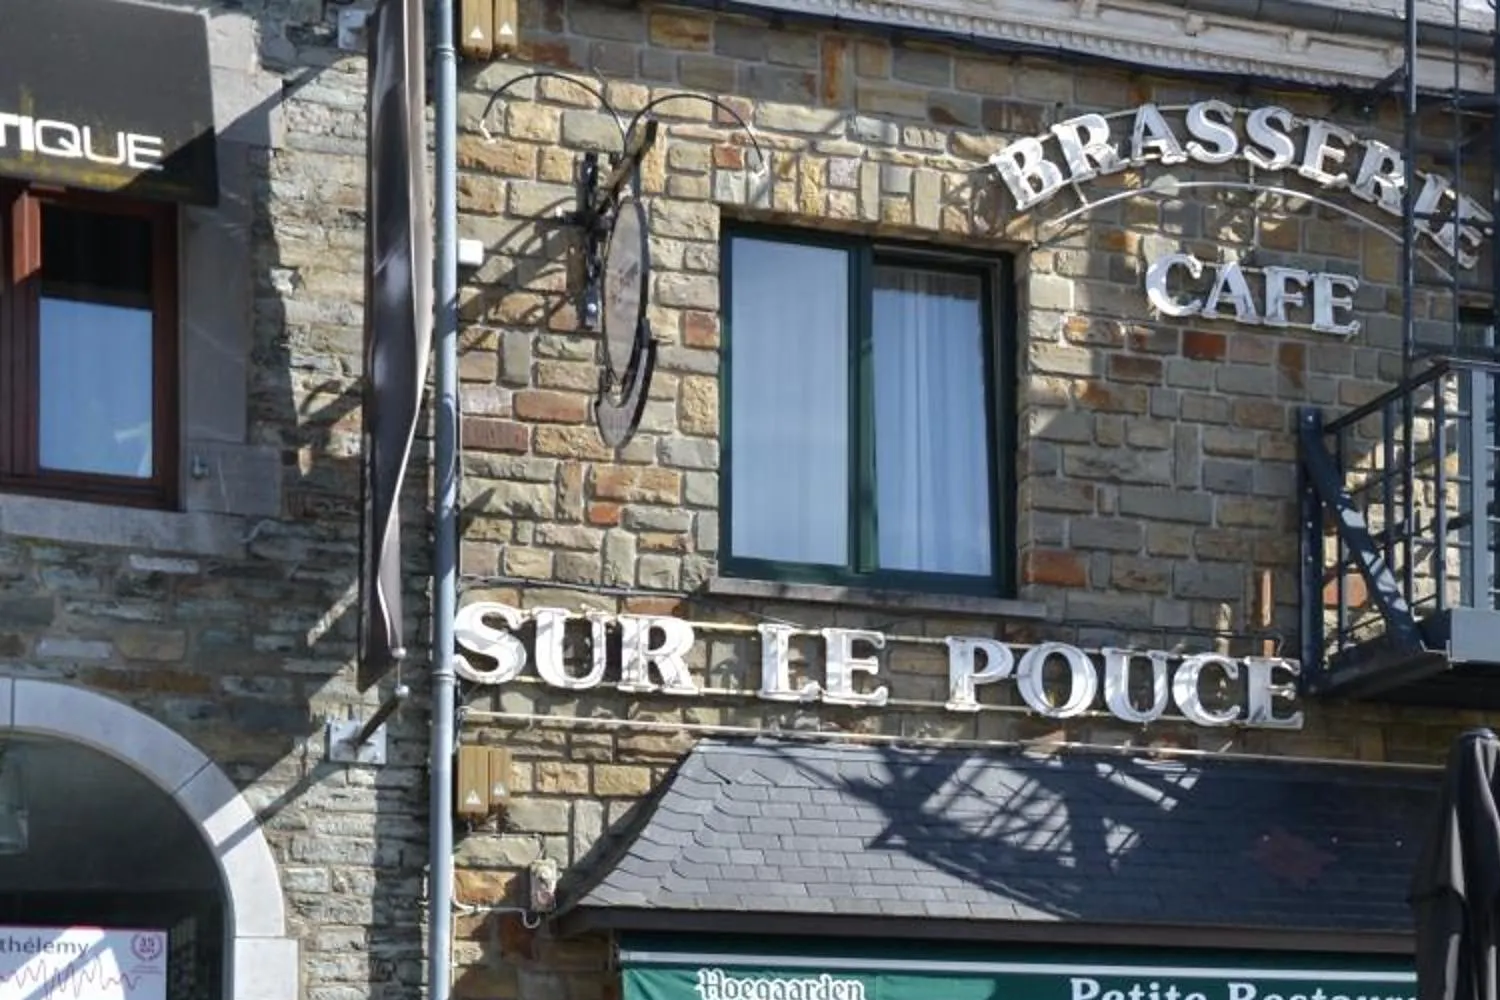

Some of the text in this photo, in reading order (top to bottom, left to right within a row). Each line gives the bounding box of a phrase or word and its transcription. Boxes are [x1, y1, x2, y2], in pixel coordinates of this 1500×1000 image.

[989, 99, 1496, 269] BRASSERIE
[1145, 252, 1361, 338] CAFE
[453, 602, 1304, 730] SUR LE POUCE
